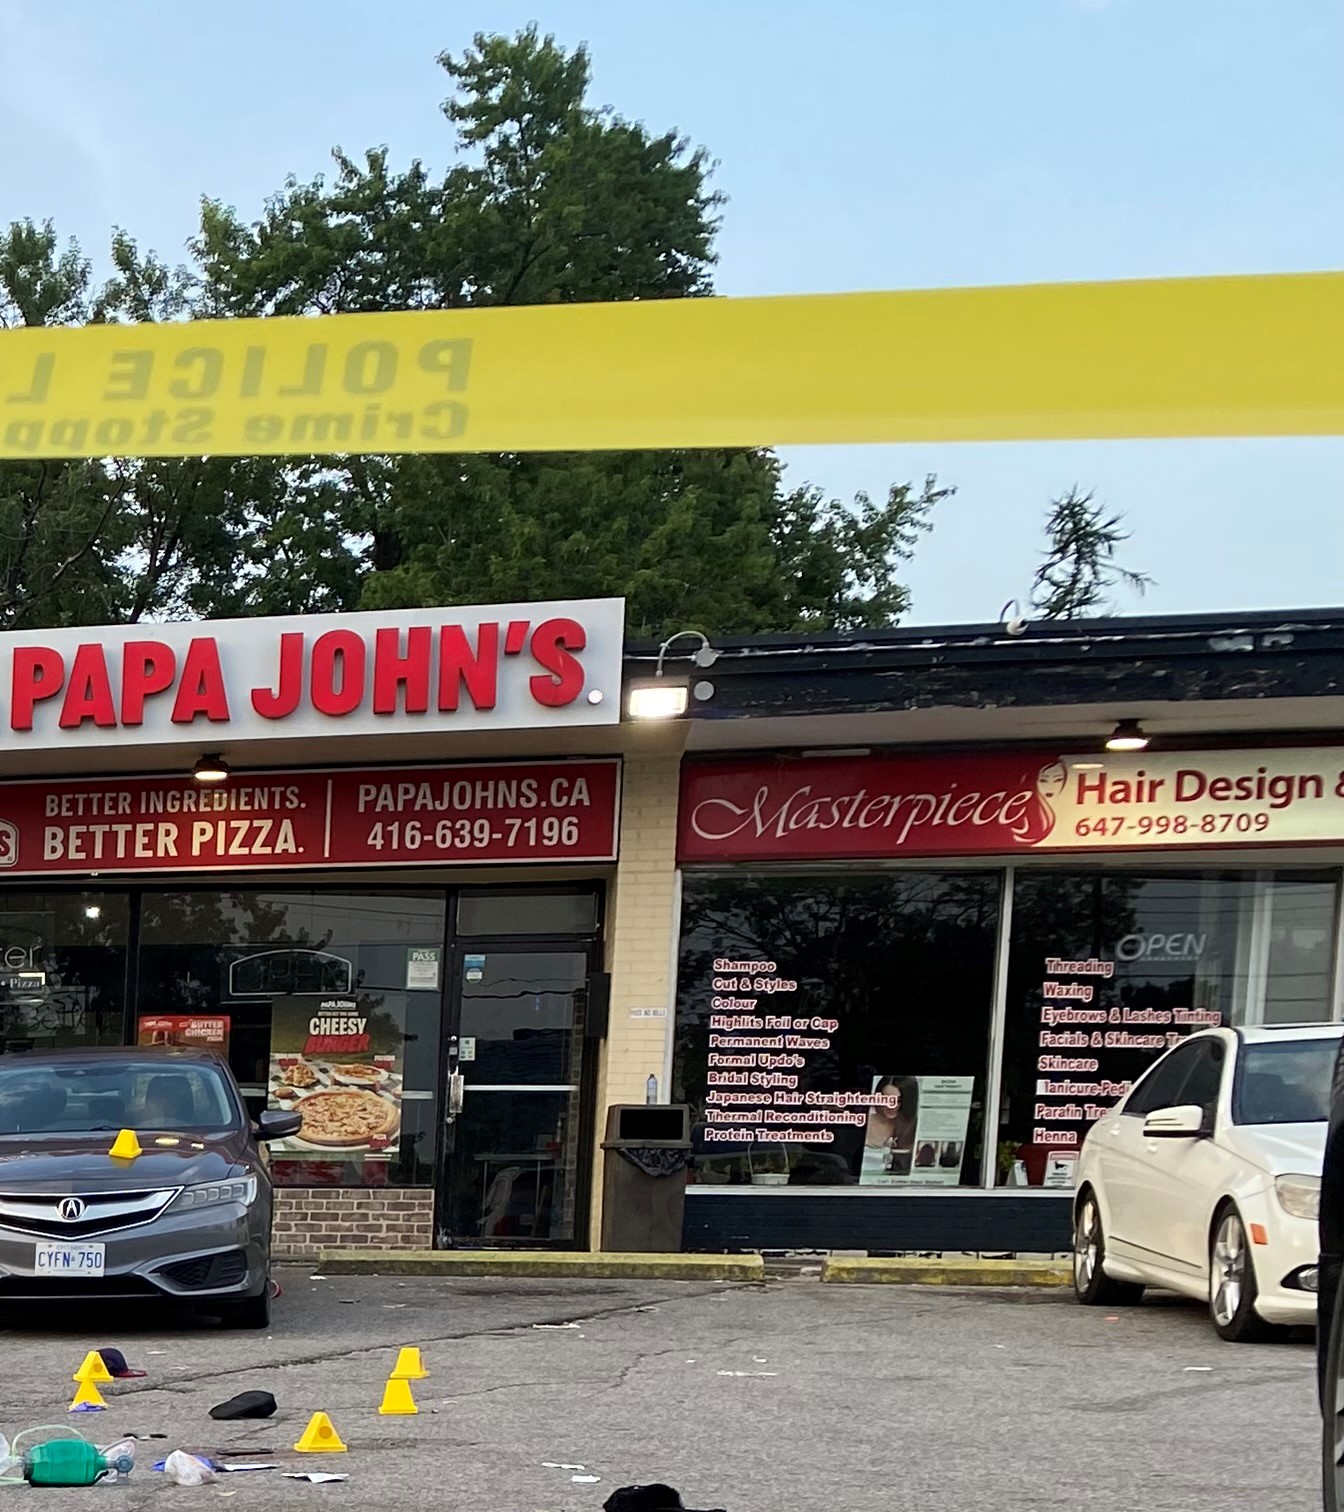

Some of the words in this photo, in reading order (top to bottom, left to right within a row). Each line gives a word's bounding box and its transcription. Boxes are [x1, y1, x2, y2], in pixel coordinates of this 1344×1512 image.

[12, 636, 230, 731] PAPA
[251, 618, 587, 720] JOHN'S
[358, 777, 591, 813] PAPAJOHNS.CA
[1076, 770, 1165, 805] Hair
[1175, 766, 1324, 809] Design
[45, 791, 132, 818] BETTER
[139, 786, 307, 814] INGREDIENTS.
[367, 816, 580, 850] 416-639-7196
[1075, 813, 1270, 837] 647-998-8709
[43, 822, 178, 861] BETTER
[191, 818, 305, 857] PIZZA.
[1116, 933, 1207, 961] OPEN
[412, 952, 436, 961] PASS
[713, 959, 777, 975] Shampoo
[1045, 958, 1114, 978] Threading
[9, 978, 41, 989] Pizza
[713, 978, 738, 991] Cut
[739, 978, 752, 991] &
[754, 978, 797, 994] Styles
[1043, 982, 1093, 1002] Waxing
[712, 997, 757, 1010] Colour
[710, 1015, 763, 1031] Highlits
[765, 1016, 792, 1029] Foil
[793, 1018, 809, 1029] or
[811, 1017, 839, 1032] Cap
[1041, 1007, 1107, 1026] Eyebrows
[1108, 1008, 1120, 1024] &
[1122, 1008, 1172, 1024] Lashes
[1172, 1008, 1222, 1027] Tinting
[185, 1028, 224, 1036] CHICKEN
[309, 1017, 367, 1035] CHEESY
[709, 1034, 784, 1048] Permanent
[785, 1035, 830, 1049] Waves
[1039, 1030, 1089, 1047] Facials
[1090, 1031, 1102, 1047] &
[1104, 1031, 1165, 1047] Skincare
[708, 1053, 756, 1067] Formal
[758, 1054, 805, 1069] Updo's
[1038, 1055, 1099, 1071] Skincare
[707, 1071, 749, 1085] Bridal
[750, 1072, 798, 1088] Styling
[706, 1090, 772, 1106] Japanese
[773, 1091, 804, 1105] Hair
[806, 1091, 899, 1108] Straightening
[705, 1109, 763, 1124] Thermal
[764, 1110, 867, 1126] Reconditioning
[1033, 1103, 1084, 1120] Parafin
[704, 1127, 754, 1141] Protein
[756, 1129, 835, 1142] Treatments
[1032, 1127, 1077, 1144] Henna
[38, 1251, 71, 1267] CYFN
[78, 1251, 102, 1268] 750
